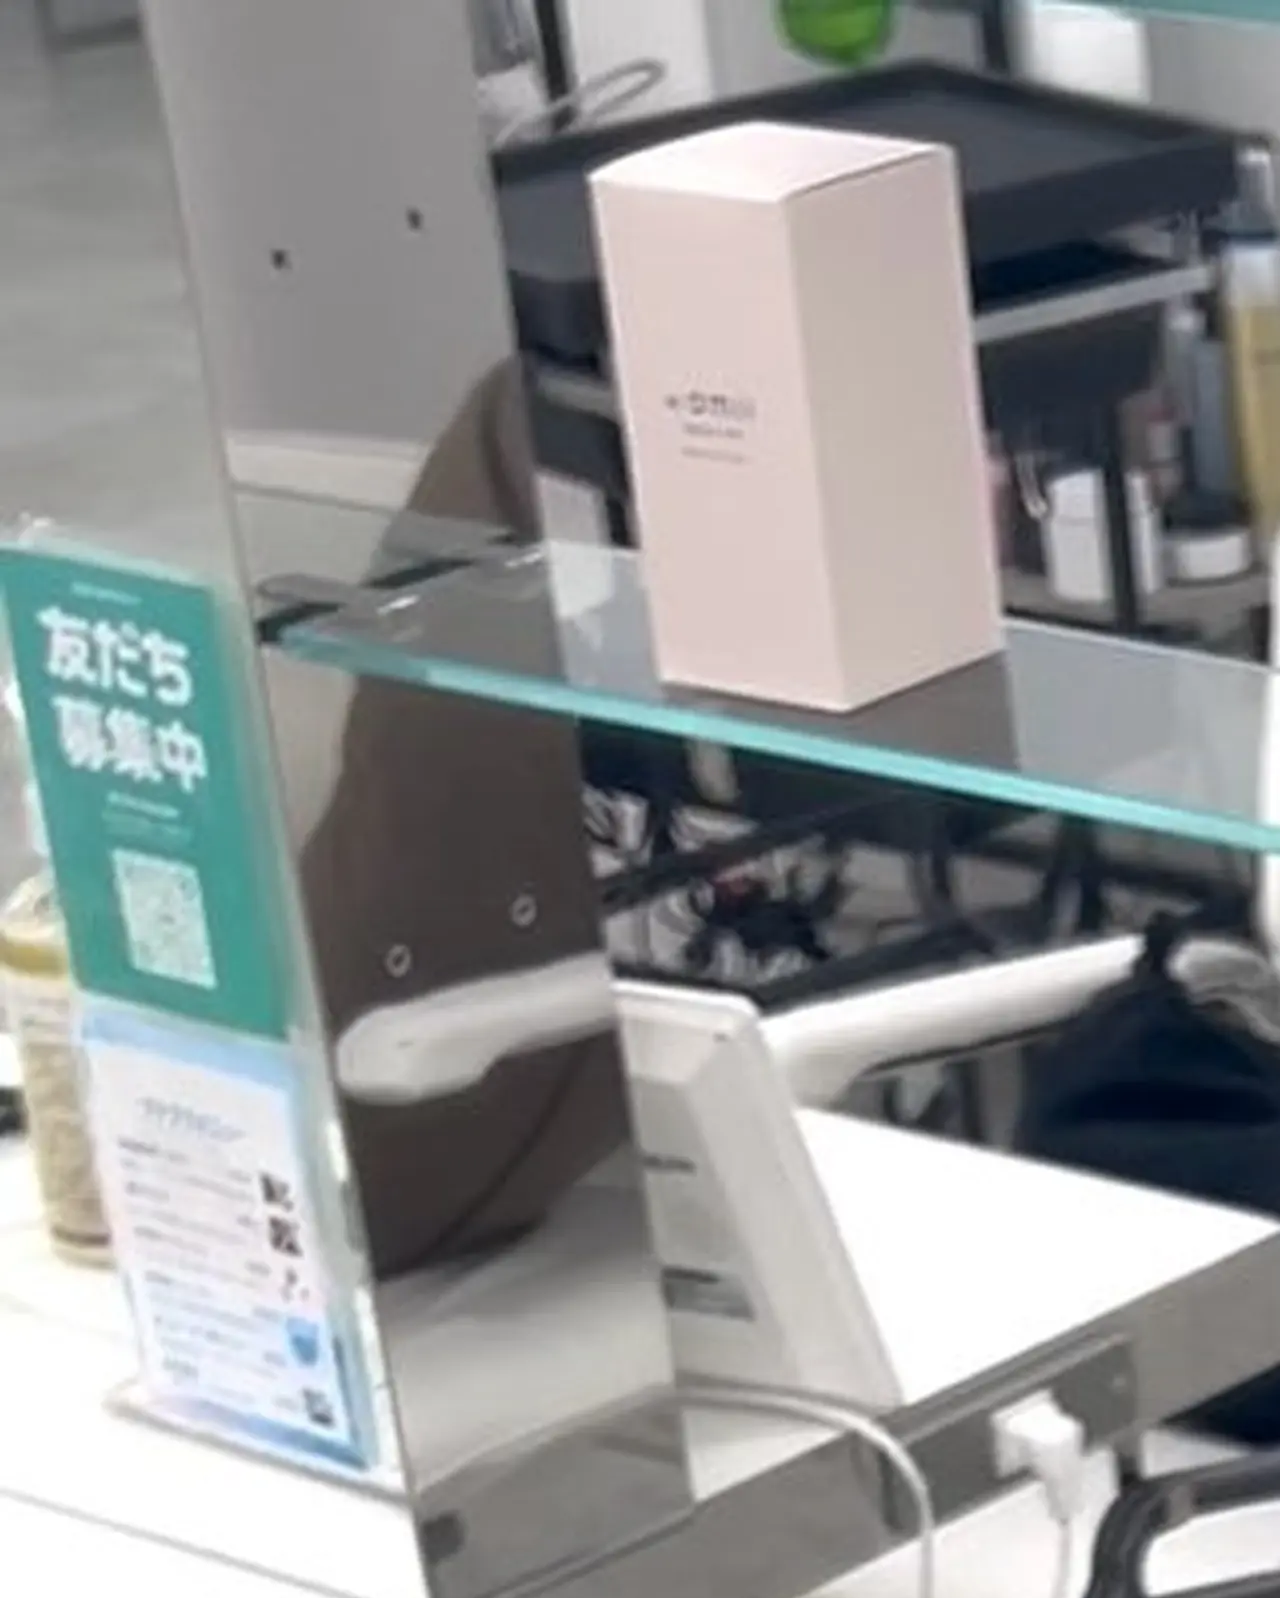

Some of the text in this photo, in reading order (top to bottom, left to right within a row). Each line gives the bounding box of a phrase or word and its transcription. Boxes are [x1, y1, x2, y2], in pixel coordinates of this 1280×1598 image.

[36, 605, 194, 707] 友だち
[51, 693, 208, 793] 募集中
